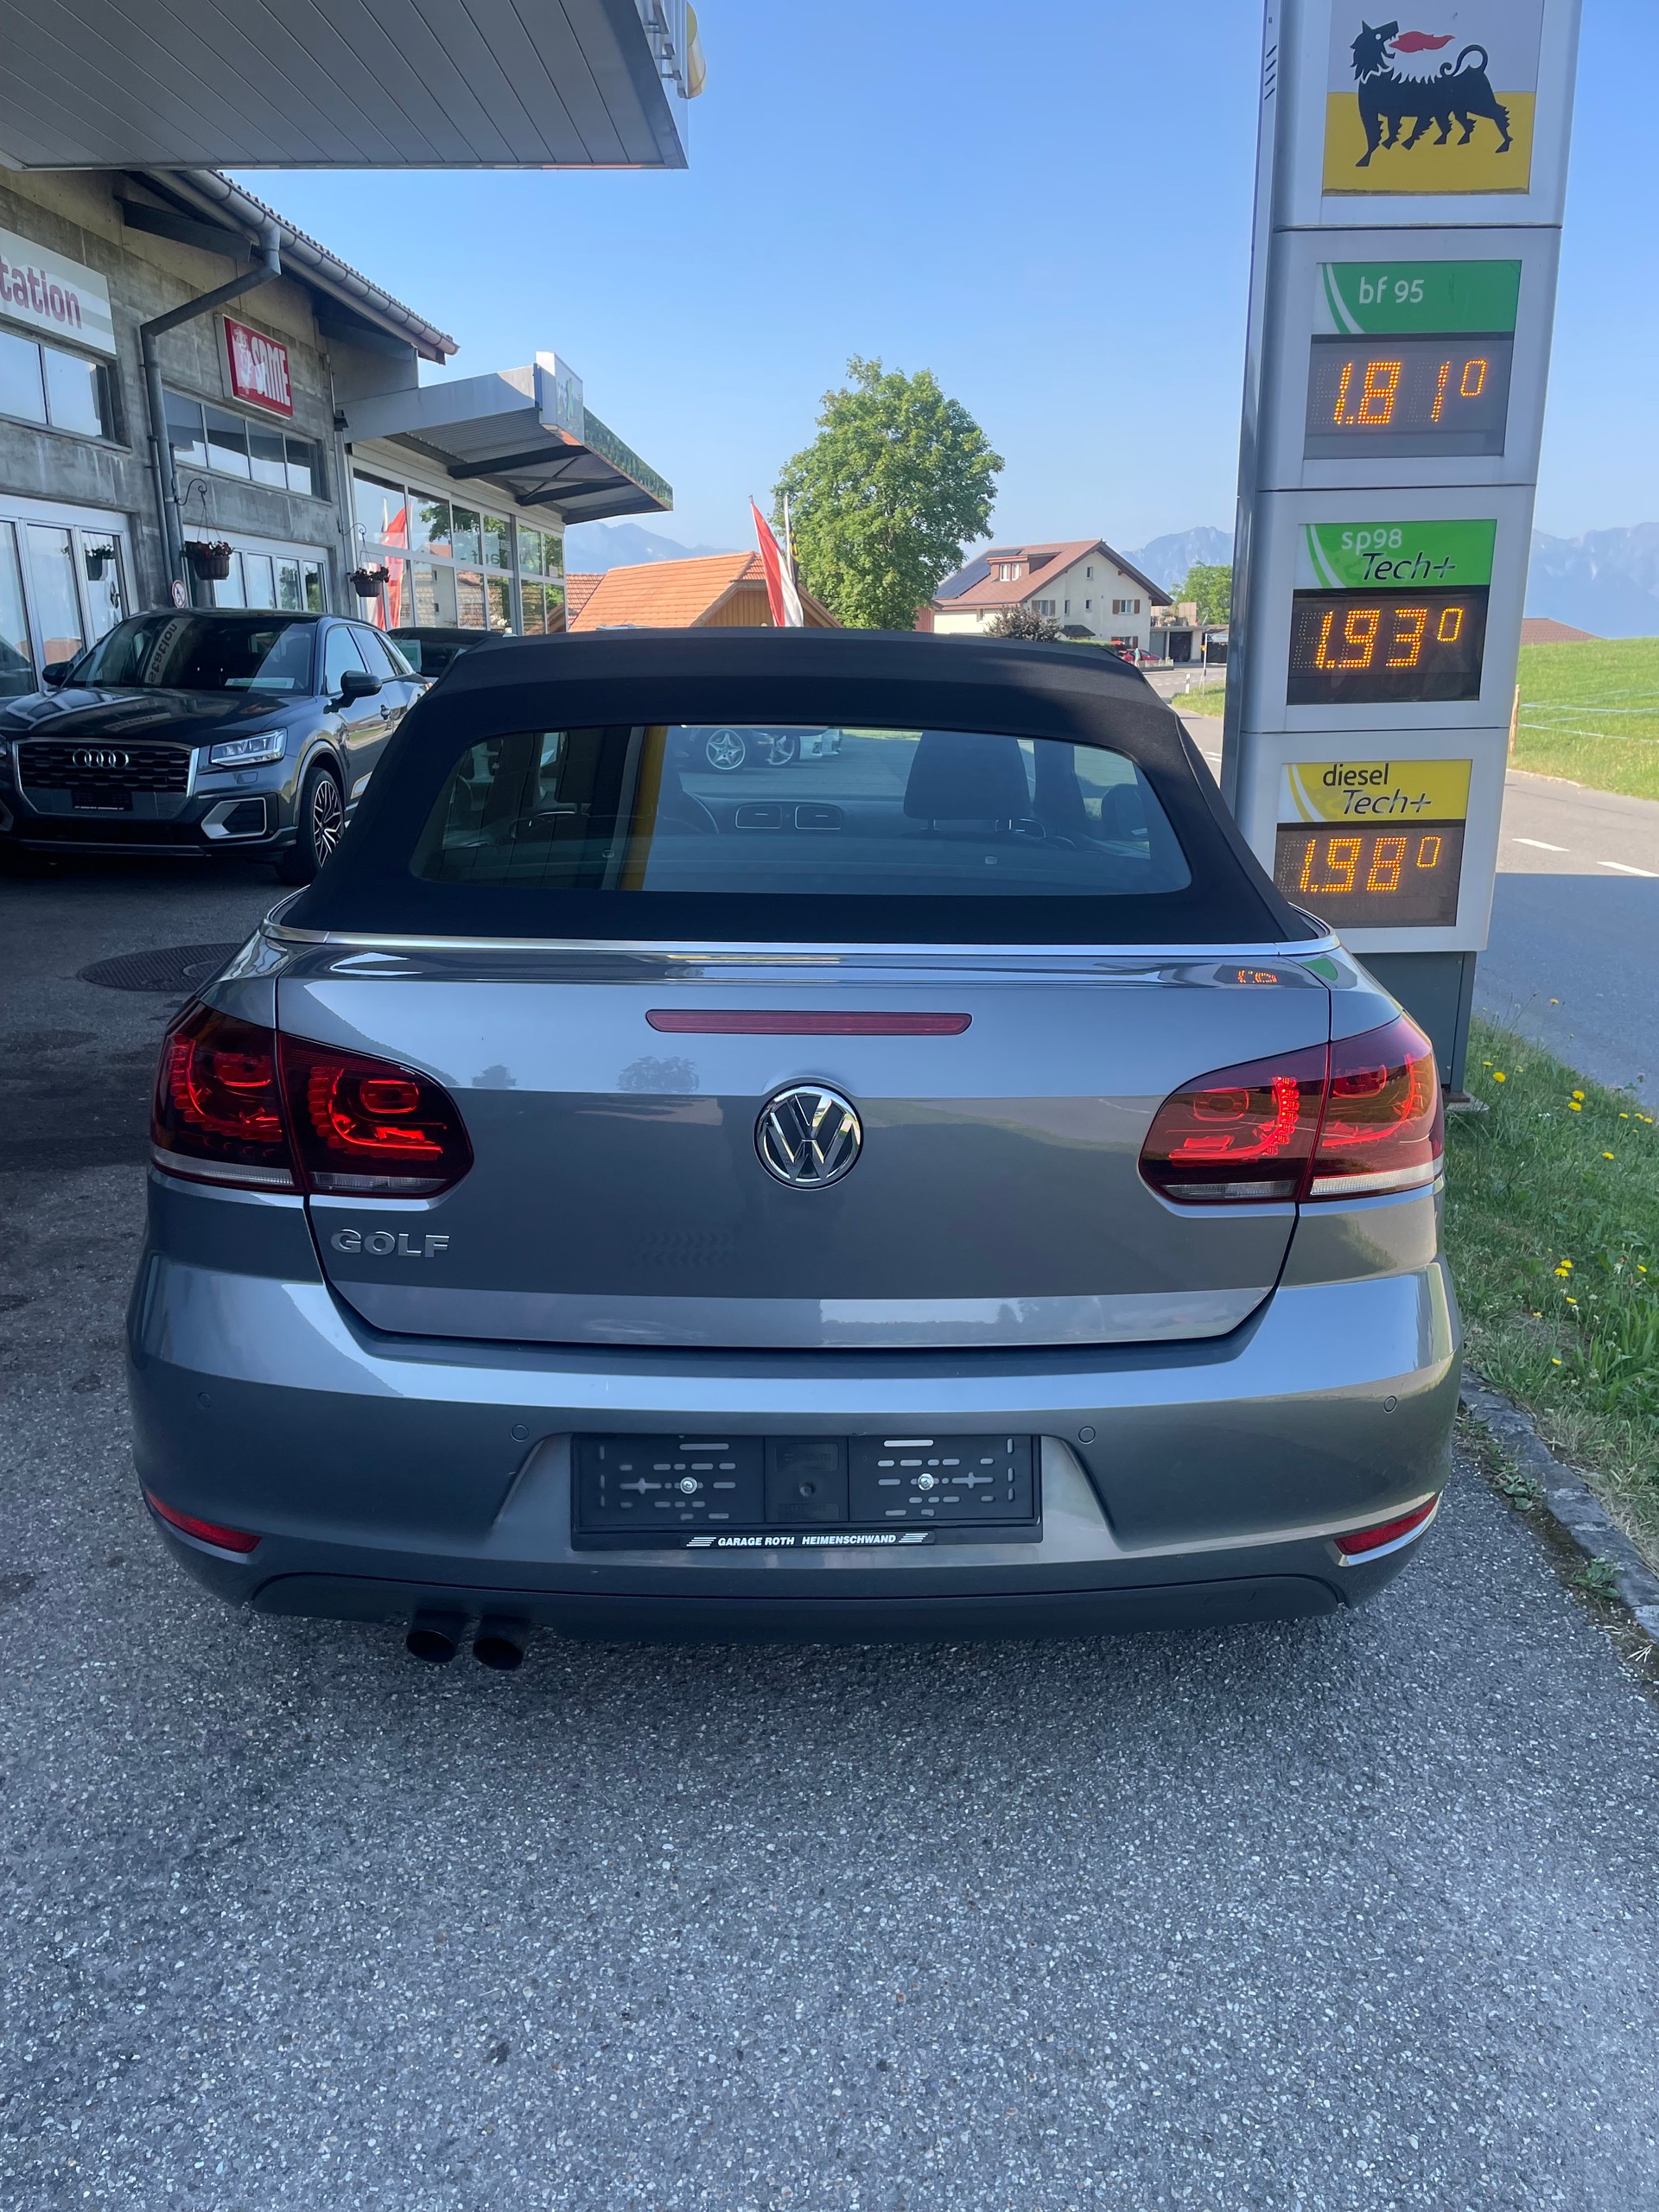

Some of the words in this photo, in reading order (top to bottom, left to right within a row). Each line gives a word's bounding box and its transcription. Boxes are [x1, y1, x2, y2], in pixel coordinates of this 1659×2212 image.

[1358, 276, 1389, 304] bf
[1394, 279, 1425, 303] 95
[251, 335, 291, 407] SAME
[1341, 528, 1402, 556] sp98
[1362, 550, 1457, 582] Tech+
[1322, 762, 1389, 787] diesel
[1341, 788, 1432, 815] Tech+
[330, 1228, 450, 1258] GOLF
[717, 1537, 763, 1547] GARAGE
[764, 1536, 795, 1546] ROTH
[801, 1535, 896, 1545] HEIMENSCHWAND
